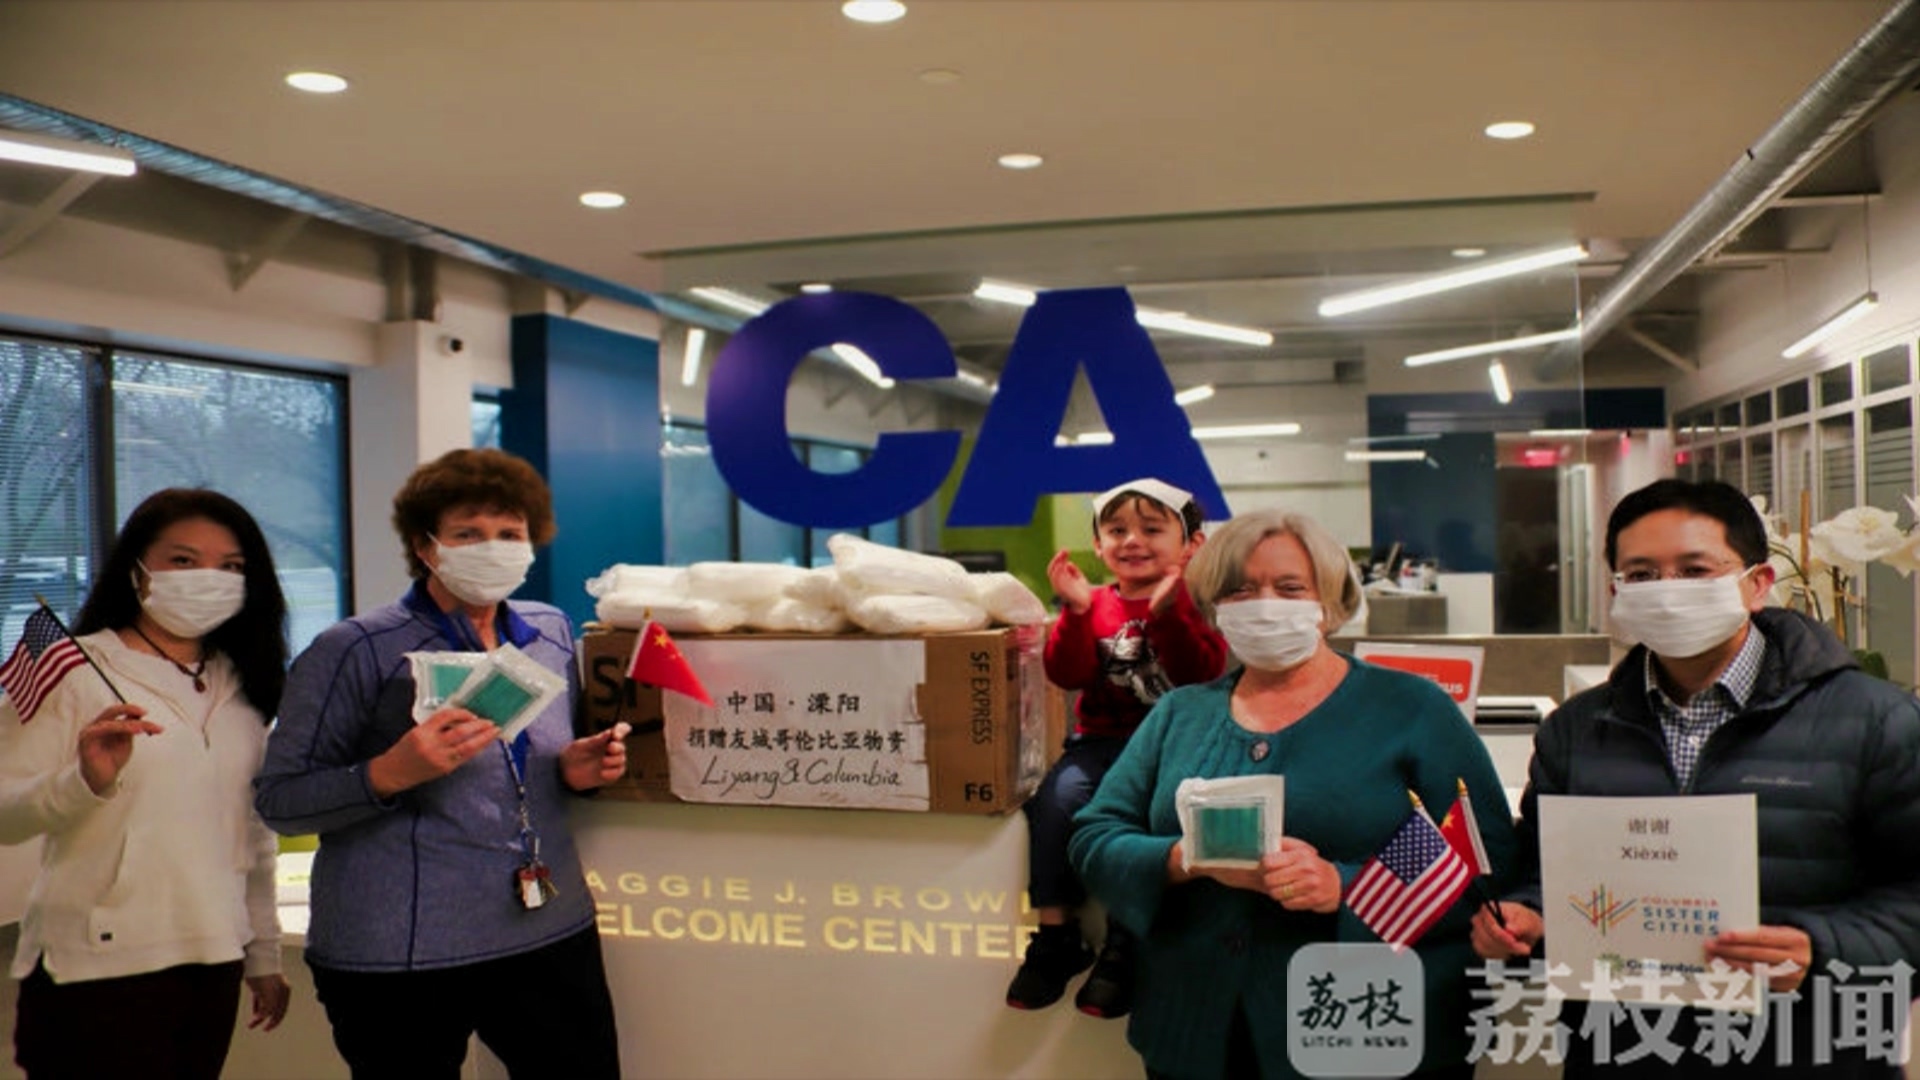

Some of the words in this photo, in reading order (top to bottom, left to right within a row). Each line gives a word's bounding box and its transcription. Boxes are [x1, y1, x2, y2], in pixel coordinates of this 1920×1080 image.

[706, 286, 1232, 530] CA
[970, 651, 990, 672] SF
[971, 677, 993, 745] EXPRESS
[965, 783, 993, 802] F6
[1628, 818, 1670, 835] 谢谢
[585, 869, 752, 901] AGGIE
[774, 880, 806, 905] J.
[831, 882, 1032, 915] BROW
[1641, 896, 1719, 907] COLUMBIA
[1643, 907, 1720, 922] SISTER
[595, 902, 807, 948] ELCOME
[1643, 920, 1720, 936] CITIES
